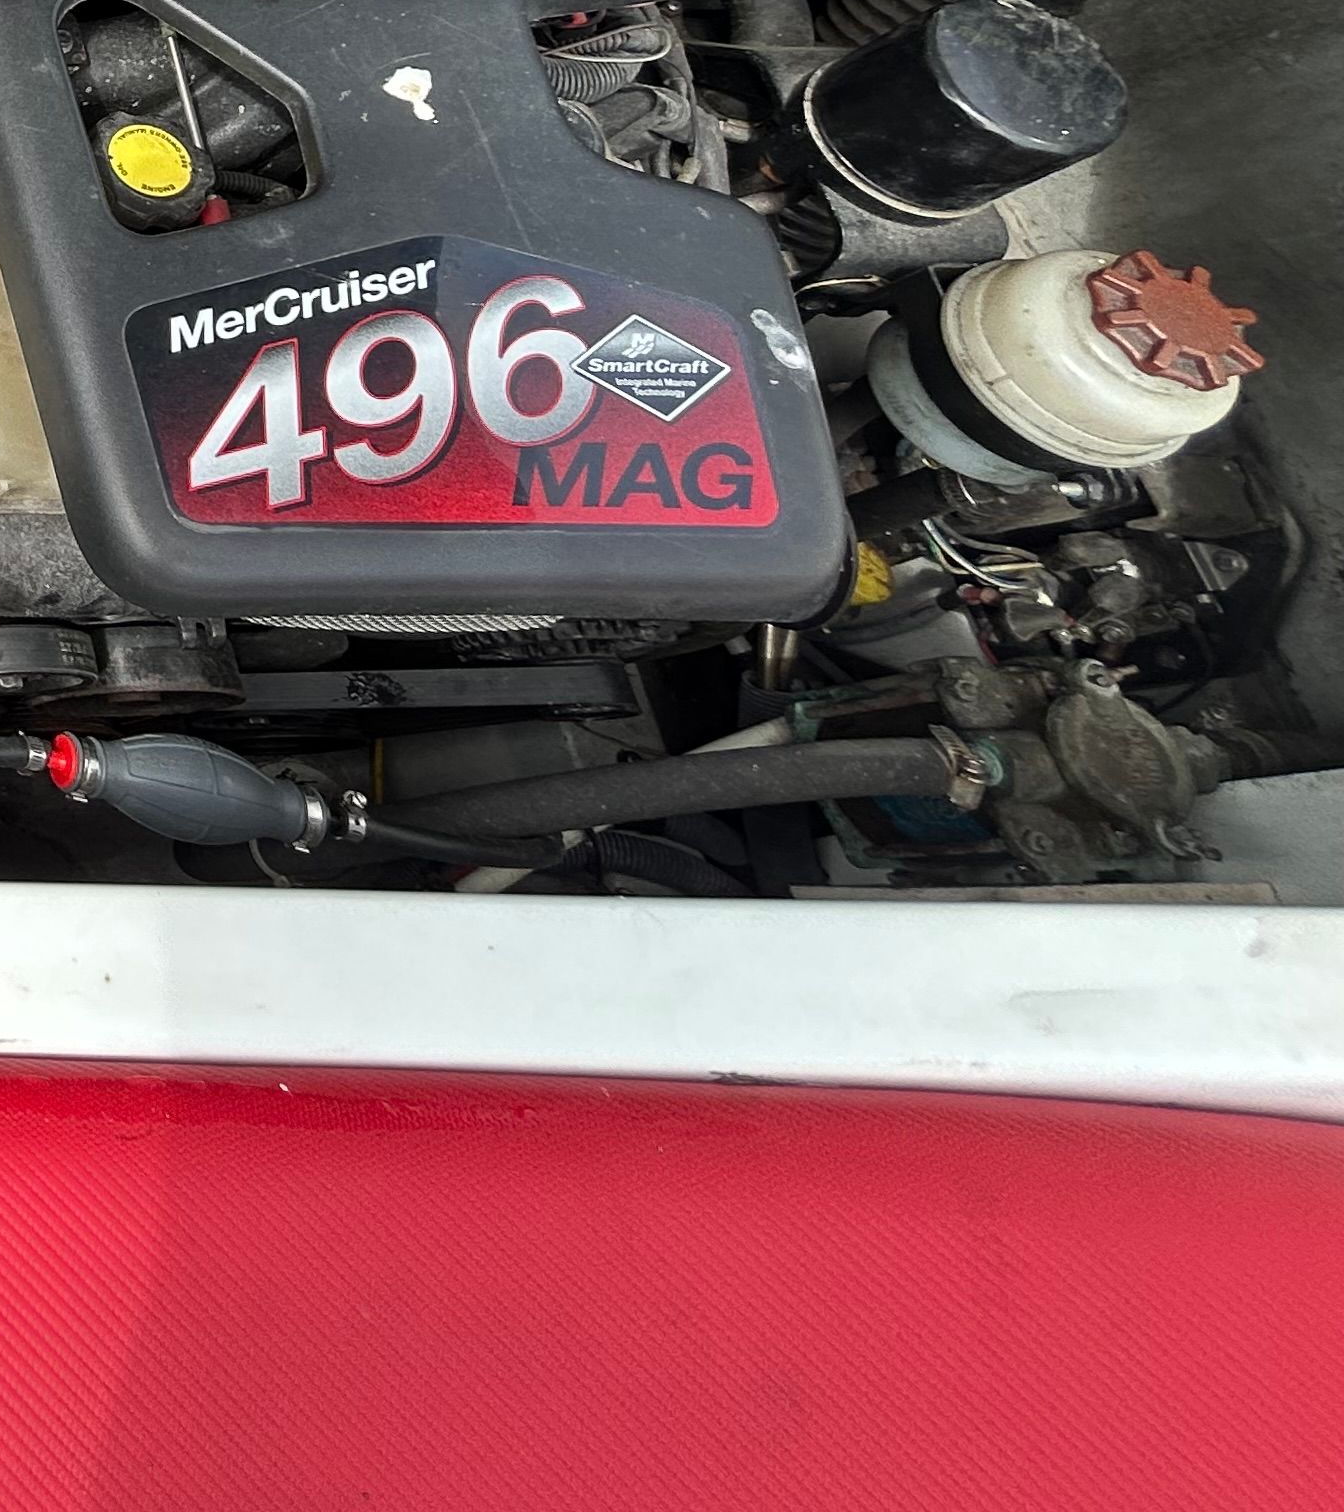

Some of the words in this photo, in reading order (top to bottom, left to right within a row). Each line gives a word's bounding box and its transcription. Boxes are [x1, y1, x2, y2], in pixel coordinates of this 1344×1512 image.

[168, 260, 436, 354] MerCruiser
[188, 274, 598, 510] 496
[588, 358, 709, 374] SmartCraft
[511, 440, 754, 510] MAG
